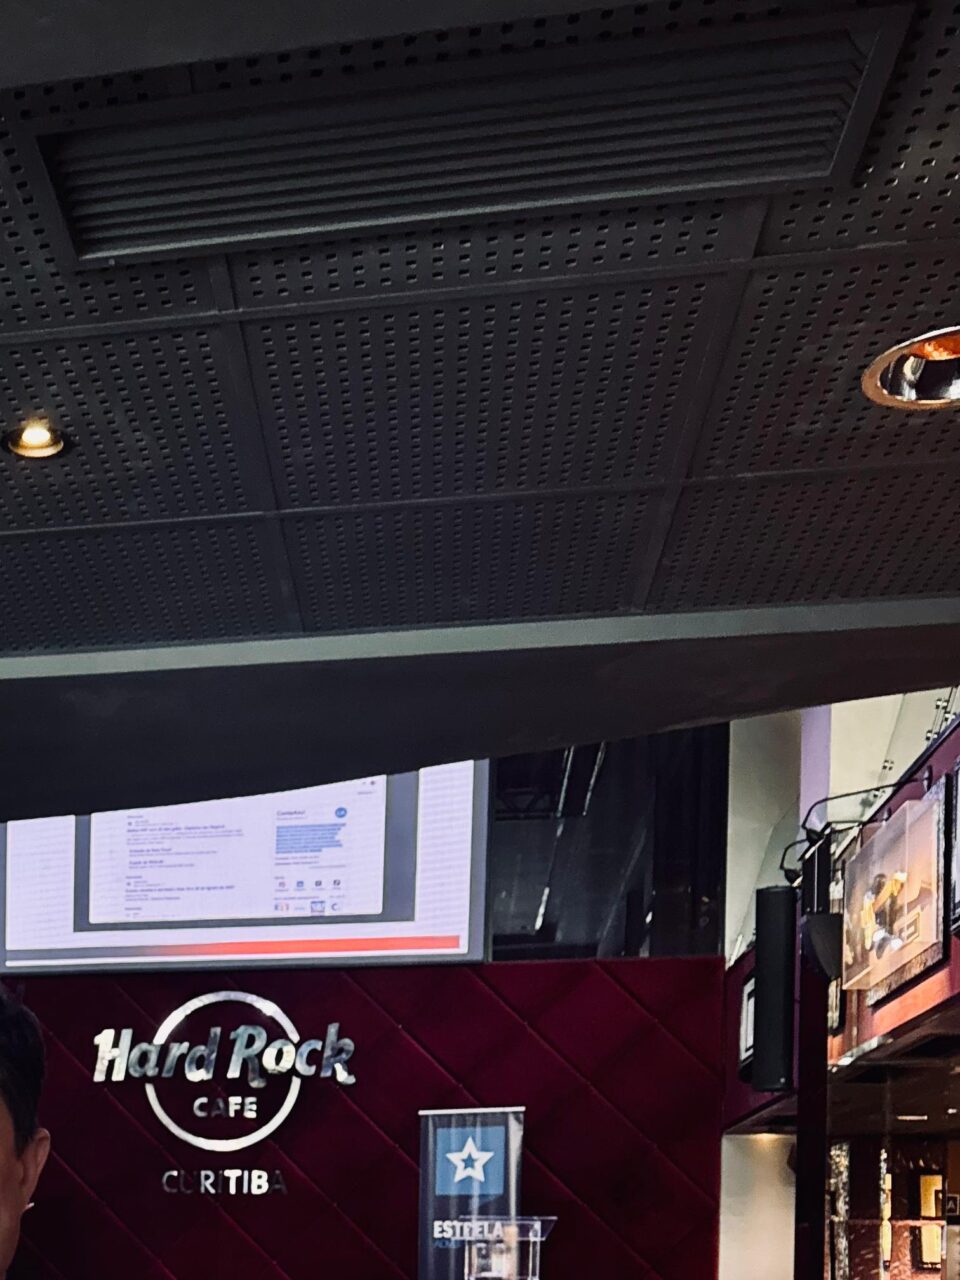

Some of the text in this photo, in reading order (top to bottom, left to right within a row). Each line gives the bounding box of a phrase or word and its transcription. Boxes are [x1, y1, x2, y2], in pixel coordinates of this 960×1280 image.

[93, 1022, 356, 1088] Hard Rock
[193, 1096, 257, 1119] CAFE
[432, 1220, 505, 1240] ESTRELA
